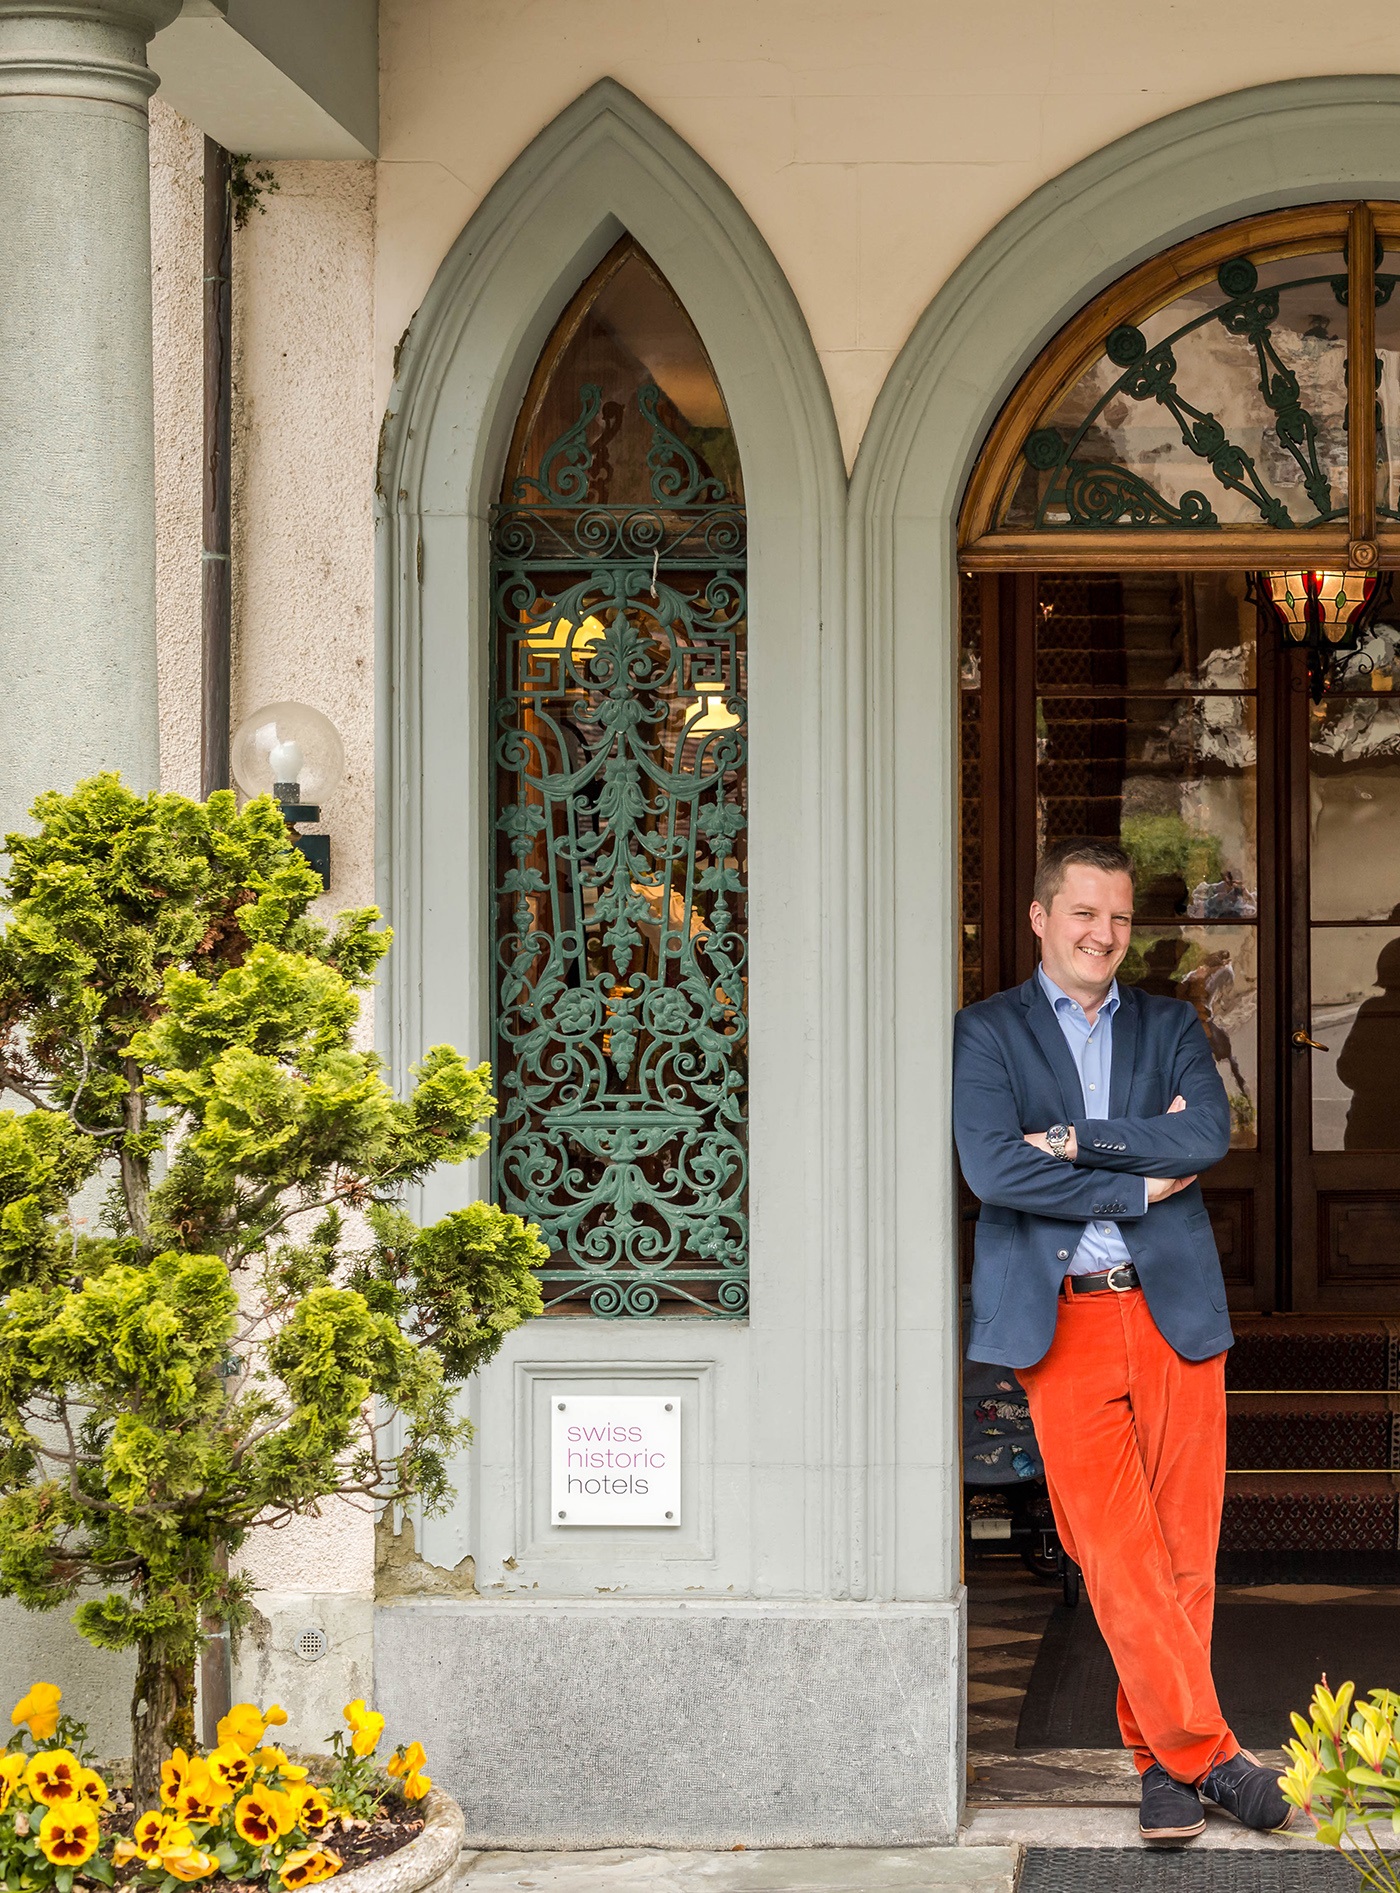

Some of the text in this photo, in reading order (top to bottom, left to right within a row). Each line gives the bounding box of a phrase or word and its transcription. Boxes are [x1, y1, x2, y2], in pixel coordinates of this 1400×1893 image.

[567, 1422, 642, 1442] swiss
[567, 1448, 665, 1468] historic
[567, 1474, 649, 1494] hotels
